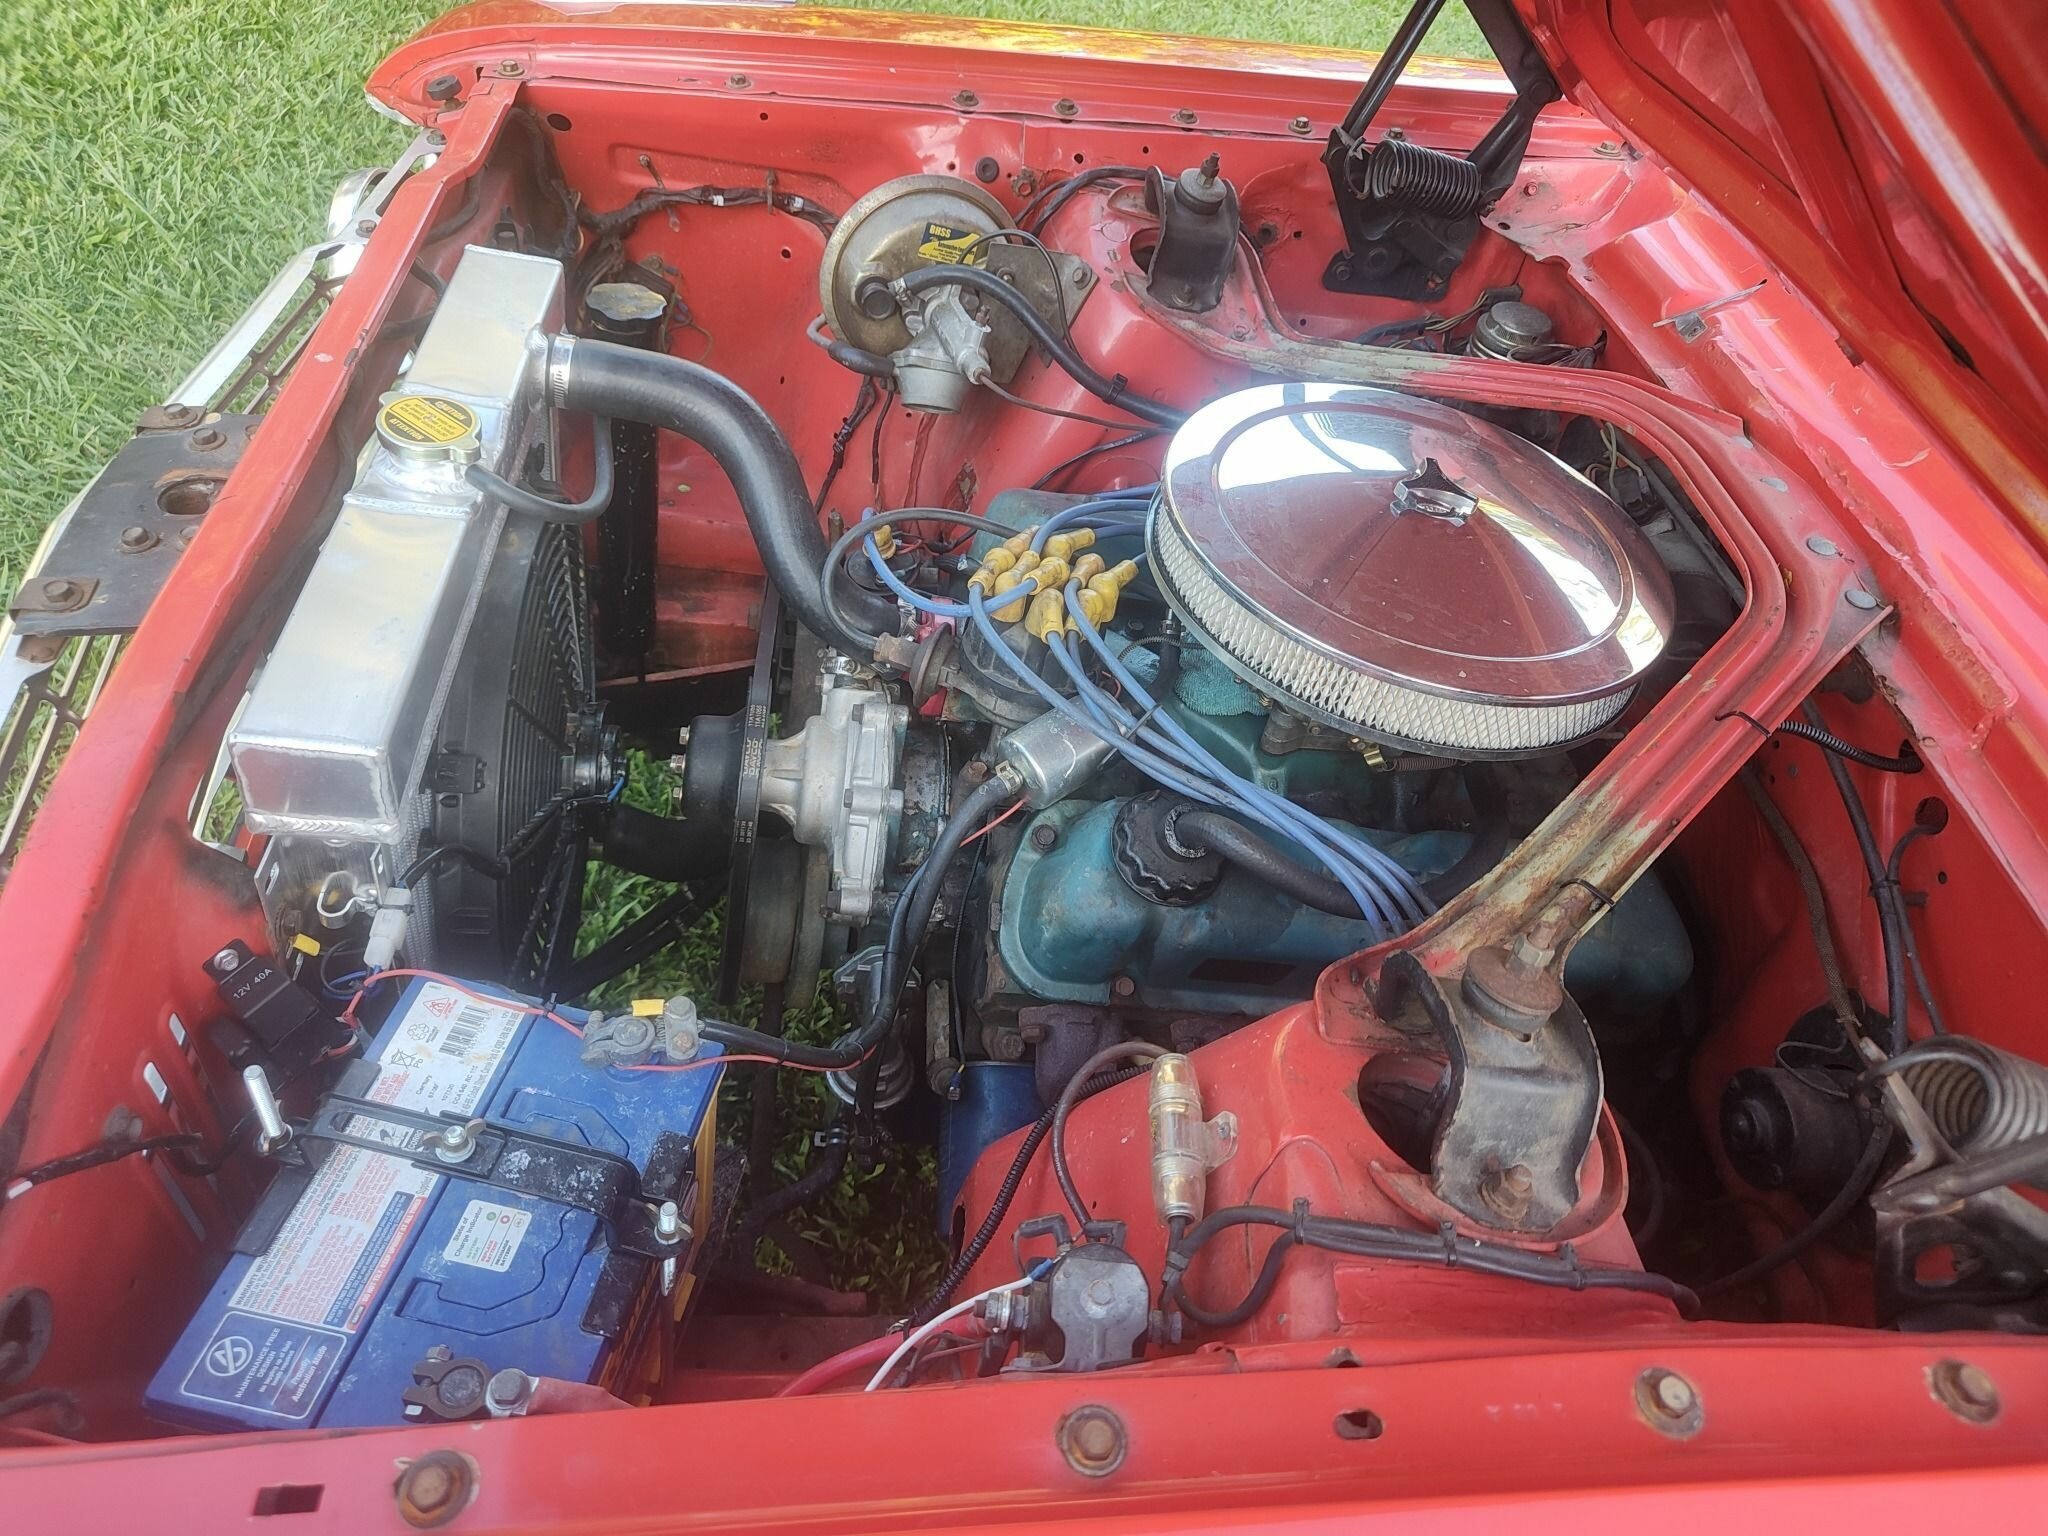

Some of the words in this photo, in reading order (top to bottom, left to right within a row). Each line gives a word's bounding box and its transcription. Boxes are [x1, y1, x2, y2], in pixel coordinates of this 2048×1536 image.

[929, 224, 952, 239] BHSS
[434, 401, 467, 421] CAUTION
[389, 418, 425, 441] ATTENTION
[748, 740, 759, 776] DAYCO
[233, 983, 251, 999] 12V
[254, 968, 273, 984] 40A
[412, 1058, 425, 1069] Pb
[328, 1191, 348, 1216] POISON
[452, 1225, 465, 1241] State
[461, 1217, 469, 1225] of
[454, 1234, 471, 1257] Charge
[466, 1206, 484, 1233] Indicator
[270, 1282, 295, 1313] WARNING
[234, 1346, 270, 1398] MAINTENANCE
[264, 1327, 281, 1346] FREE
[256, 1350, 277, 1378] DESIGN
[290, 1357, 312, 1385] Proudly
[291, 1365, 318, 1403] Australian
[311, 1345, 329, 1365] Made
